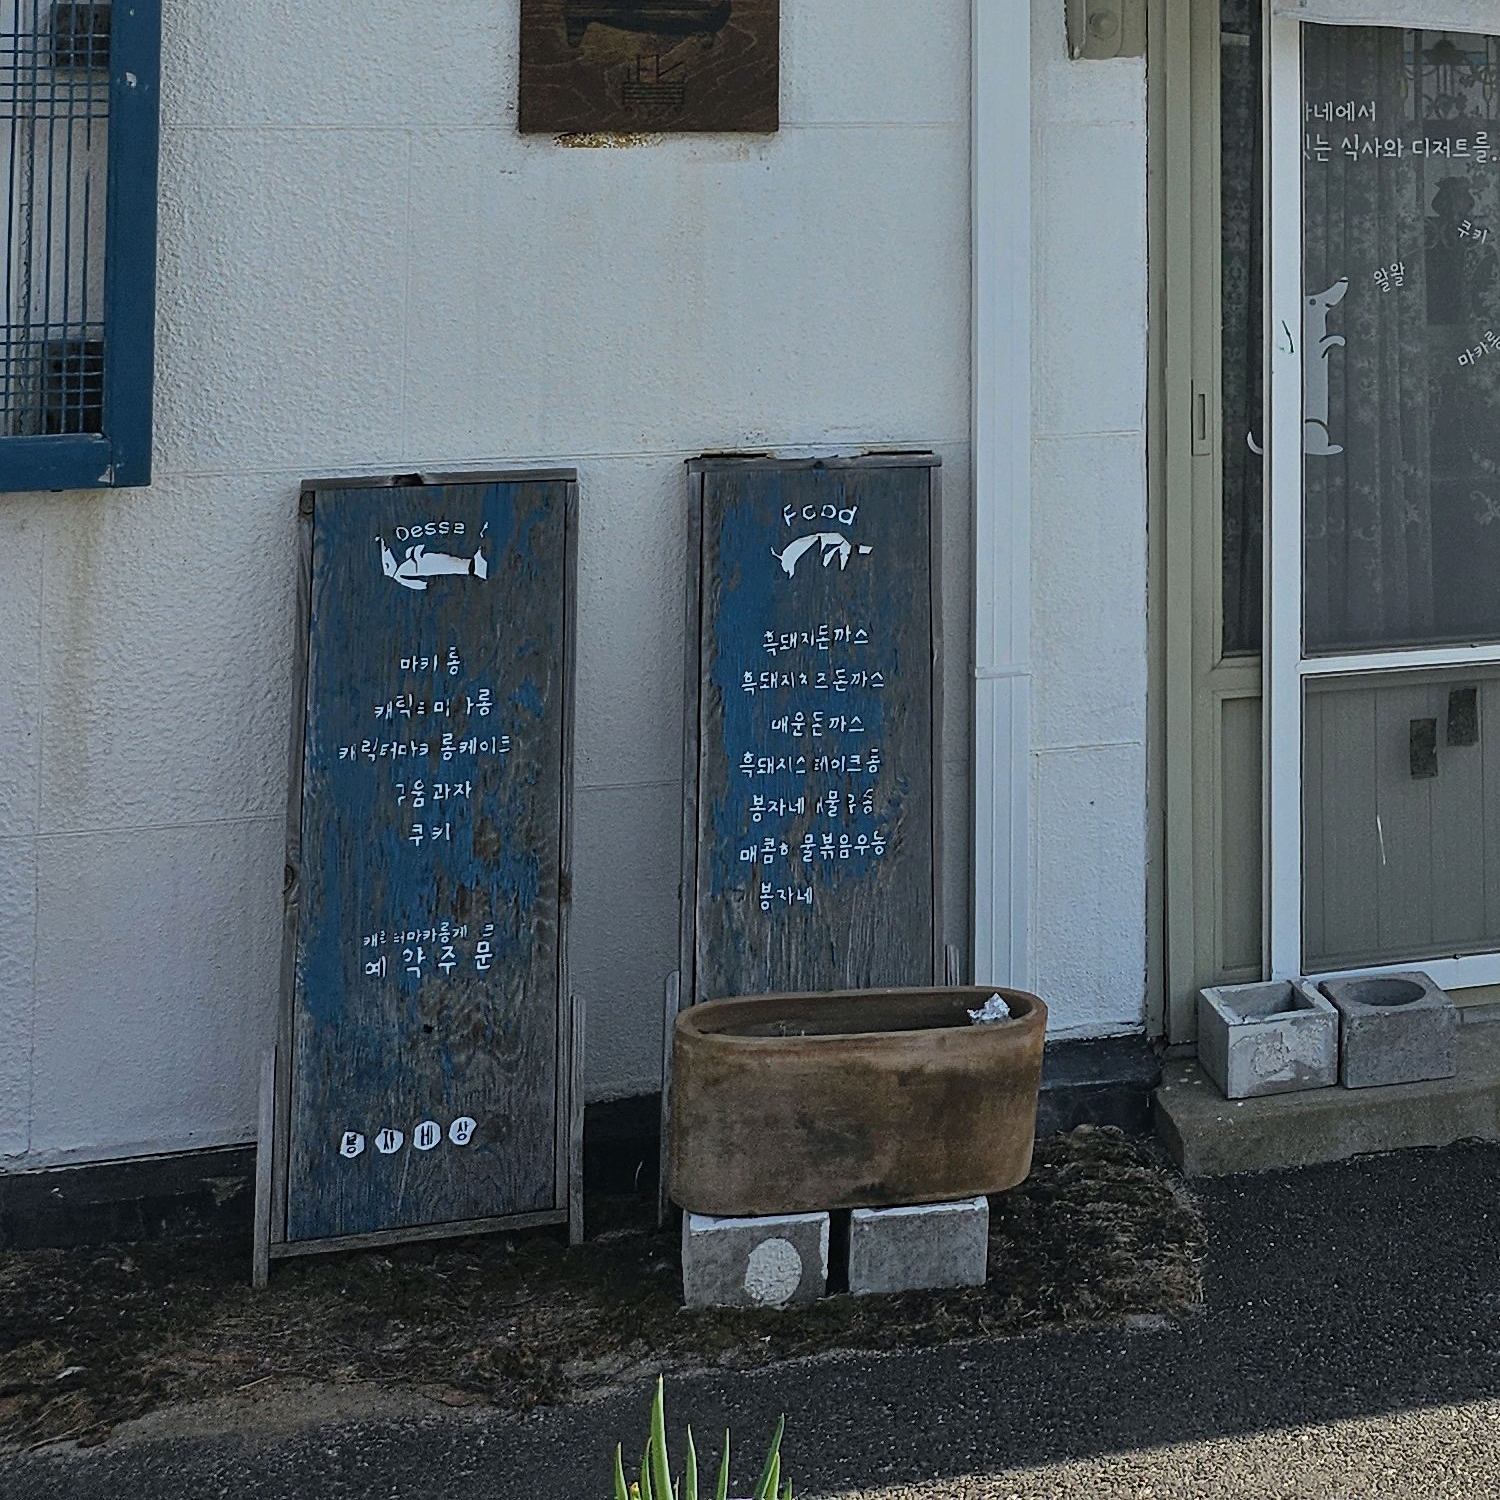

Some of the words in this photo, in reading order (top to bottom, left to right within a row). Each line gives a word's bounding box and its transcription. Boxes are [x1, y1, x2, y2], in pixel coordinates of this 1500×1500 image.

[1341, 134, 1402, 161] 식사와
[1457, 220, 1488, 244] 쿠키
[1373, 261, 1405, 293] 왈왈
[762, 624, 869, 656] 흑돼지돈까스
[408, 823, 451, 846] 쿠키
[759, 881, 814, 911] 봉자네
